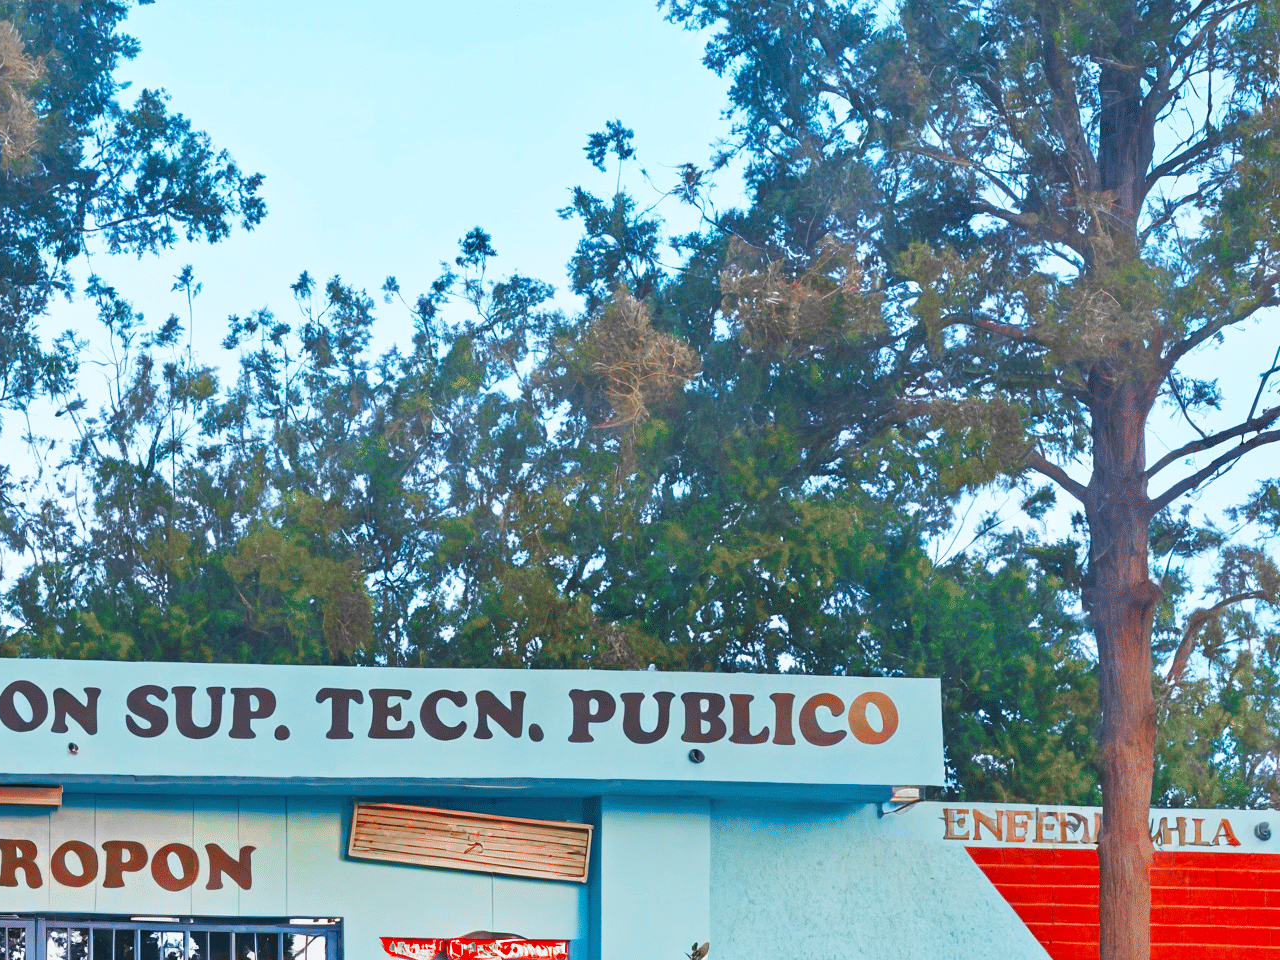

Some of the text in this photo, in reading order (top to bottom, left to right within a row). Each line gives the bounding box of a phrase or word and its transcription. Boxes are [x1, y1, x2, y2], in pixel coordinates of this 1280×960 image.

[125, 684, 291, 741] SUP.
[315, 687, 544, 743] TECN.
[567, 688, 899, 747] PUBLICO
